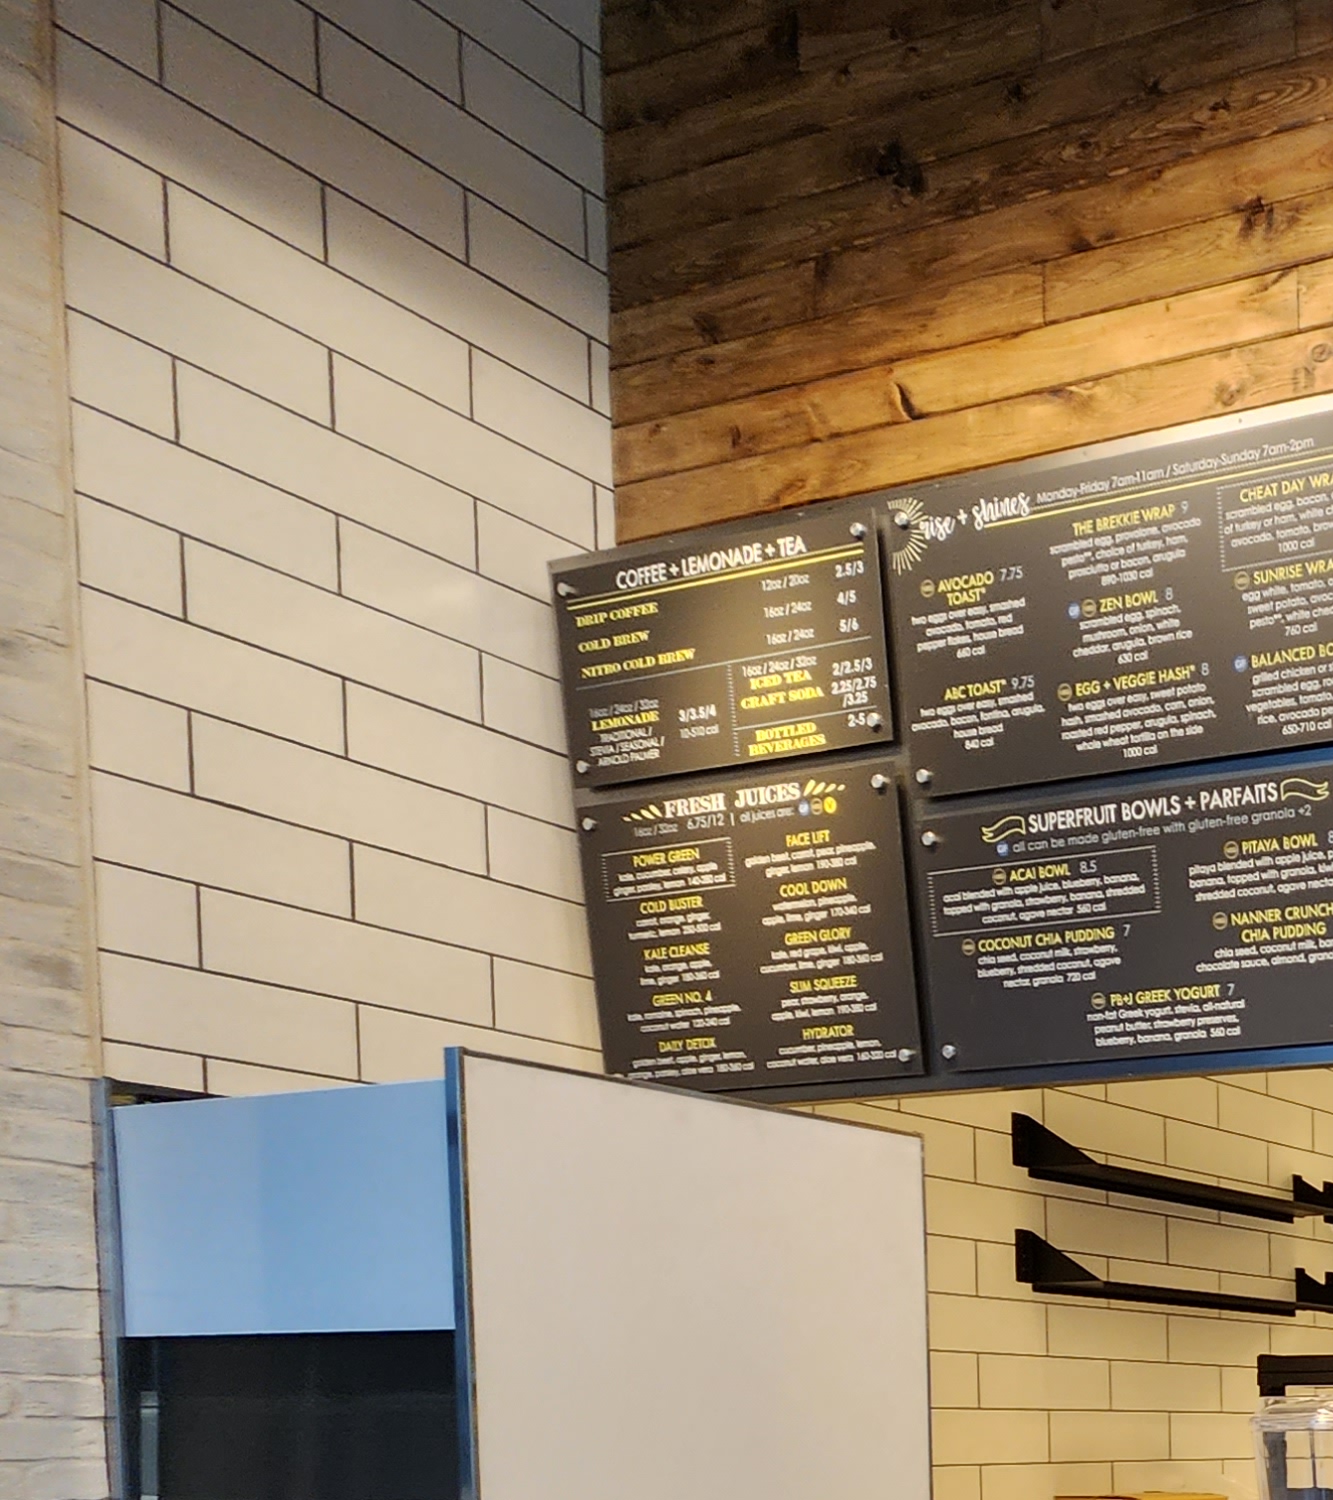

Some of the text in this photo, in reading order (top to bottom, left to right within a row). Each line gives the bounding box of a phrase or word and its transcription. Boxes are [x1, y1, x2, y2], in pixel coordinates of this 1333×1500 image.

[1240, 483, 1278, 503] CHEAT
[1282, 478, 1305, 494] DAY
[919, 491, 1031, 541] rise + shines
[616, 535, 807, 589] COFFEE + LEMONADE + TEA
[1254, 564, 1302, 585] SUNRISE
[938, 566, 1023, 592] AVOCADO 7.75
[576, 602, 658, 627] DRIP COFFEE
[582, 648, 695, 678] NITRO COLD BREW
[1252, 646, 1315, 668] BALANCED
[664, 783, 800, 818] FRESH JUICES
[1028, 782, 1277, 834] SUPERFRUIT BOWLS + PARFAITS
[1242, 838, 1280, 854] PITAYA
[1283, 833, 1318, 850] BOWL
[978, 924, 1130, 952] COCONUT CHIA PUDDING 7
